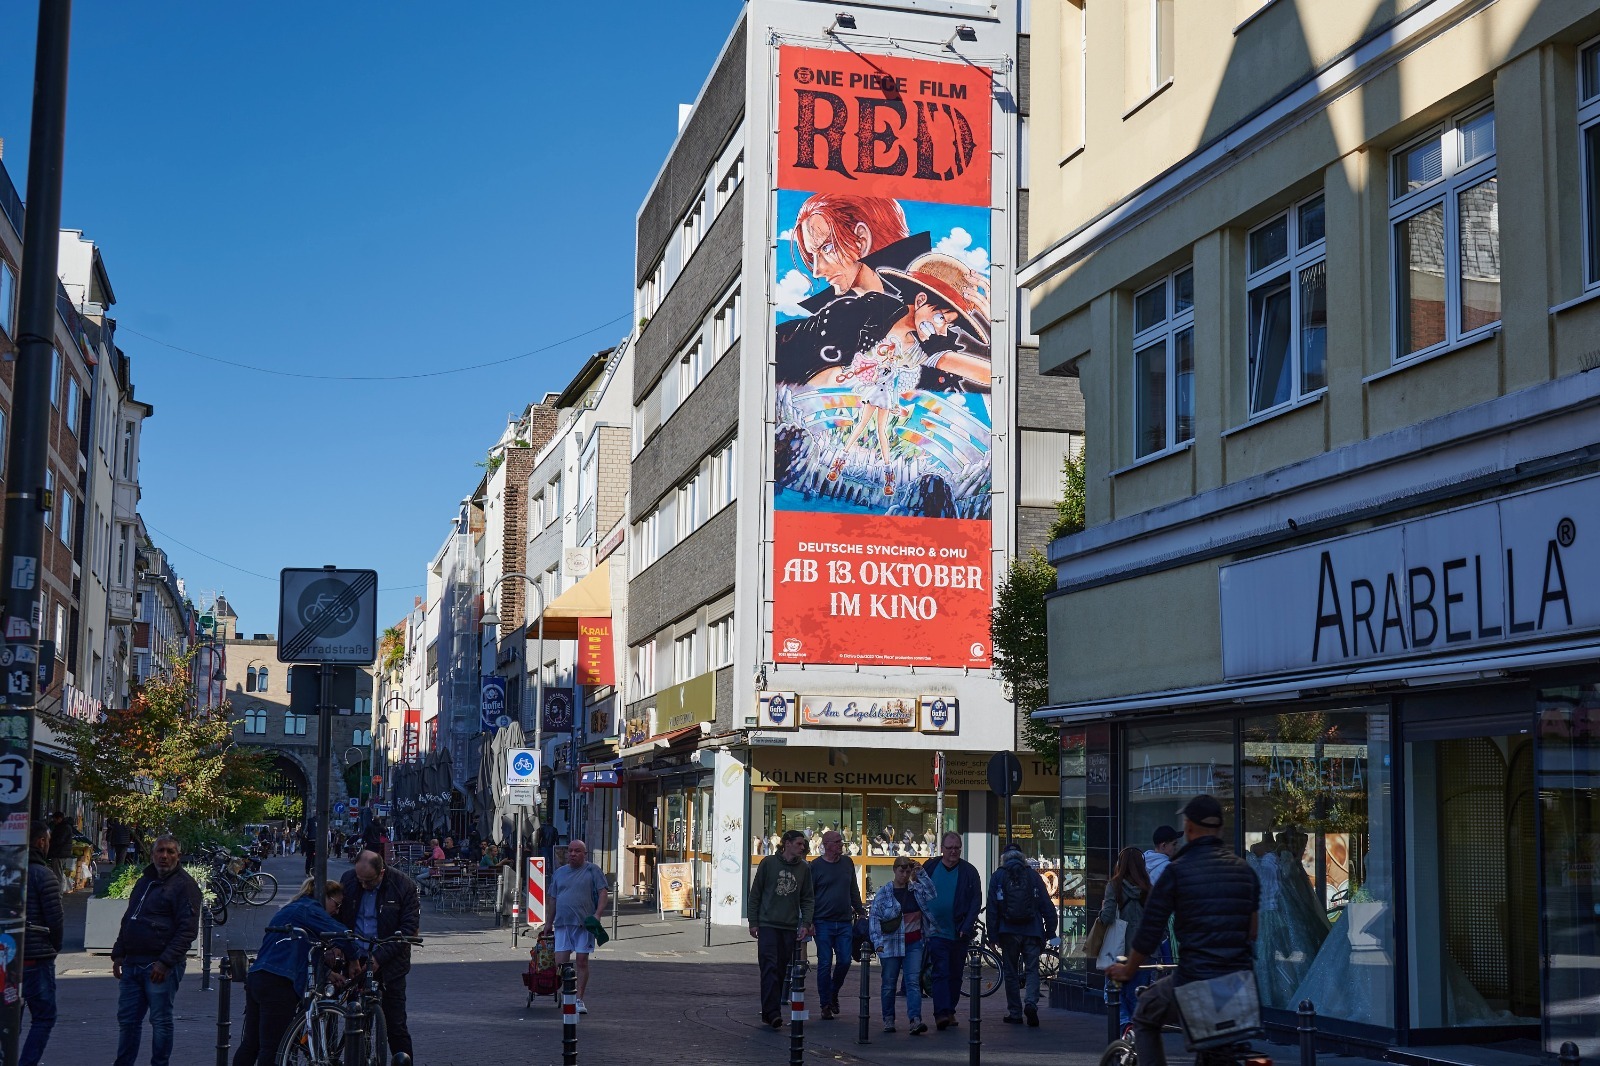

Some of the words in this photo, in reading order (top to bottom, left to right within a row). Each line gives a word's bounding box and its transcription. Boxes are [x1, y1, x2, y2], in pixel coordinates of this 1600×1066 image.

[794, 66, 844, 87] ONE
[849, 72, 908, 93] PIECE
[919, 80, 967, 100] FILM
[792, 88, 977, 181] RED
[798, 541, 863, 554] DEUTSCHE
[866, 545, 926, 557] SYNCHRO
[928, 547, 937, 557] &
[939, 547, 968, 558] OMU
[780, 558, 819, 583] AB
[825, 559, 856, 584] 13.
[858, 560, 985, 591] OKTOBER
[830, 591, 861, 617] IM
[869, 593, 938, 621] KINO
[580, 625, 610, 636] KRALL
[587, 636, 602, 683] BETTEN
[482, 700, 504, 710] Gaffel
[770, 705, 786, 713] Gaffel
[813, 701, 840, 717] Am
[405, 722, 419, 764] REWE
[760, 768, 828, 784] KÖLNER
[833, 771, 917, 786] SCHMUCK
